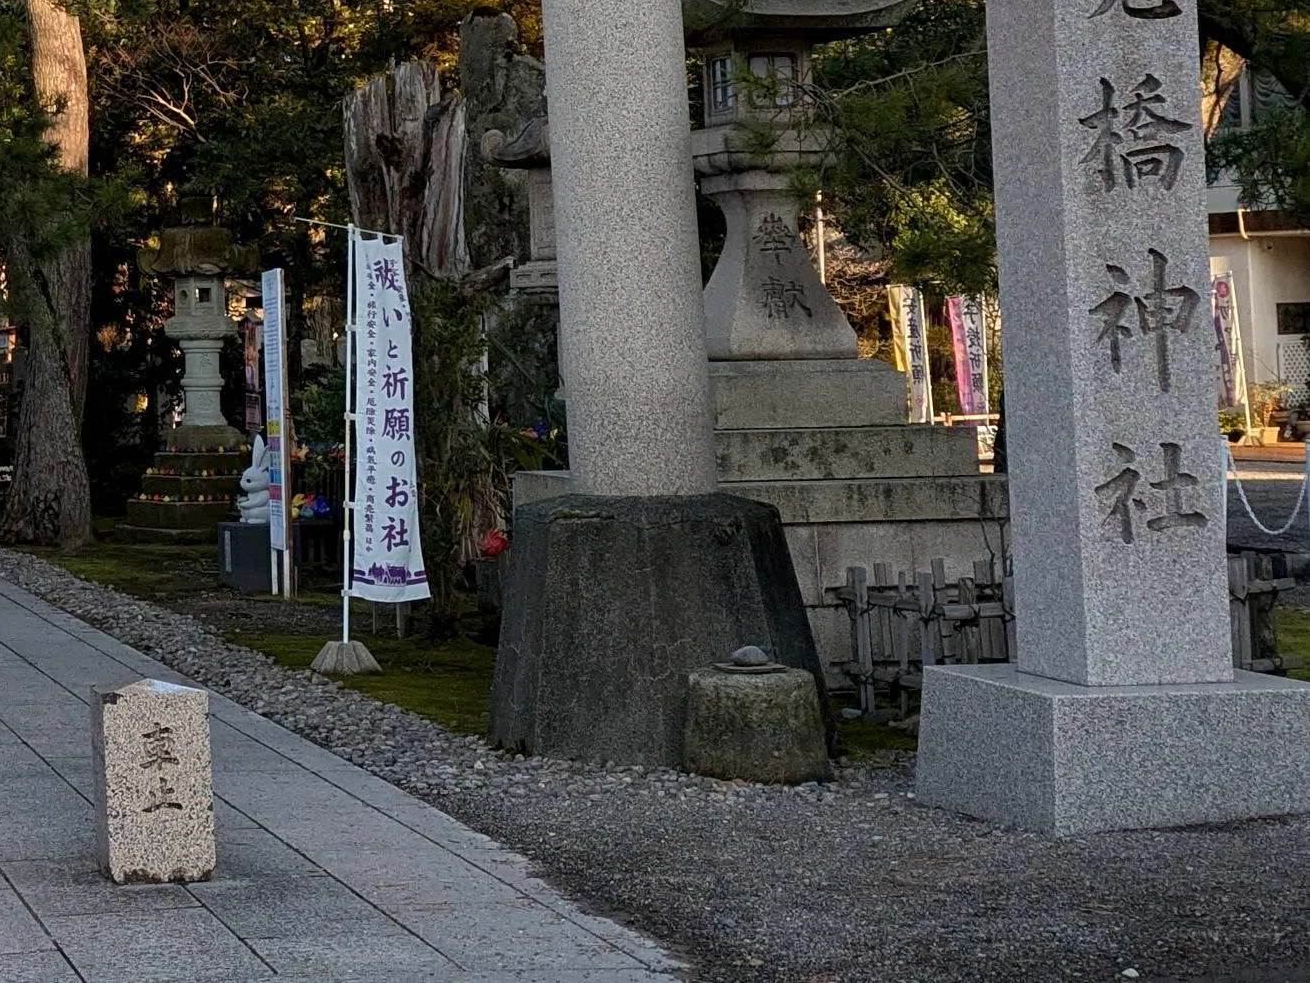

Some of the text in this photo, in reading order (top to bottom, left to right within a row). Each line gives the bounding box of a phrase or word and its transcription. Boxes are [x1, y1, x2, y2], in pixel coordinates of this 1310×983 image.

[373, 258, 411, 552] 祓いと祈願のお社
[139, 721, 183, 813] 車止
